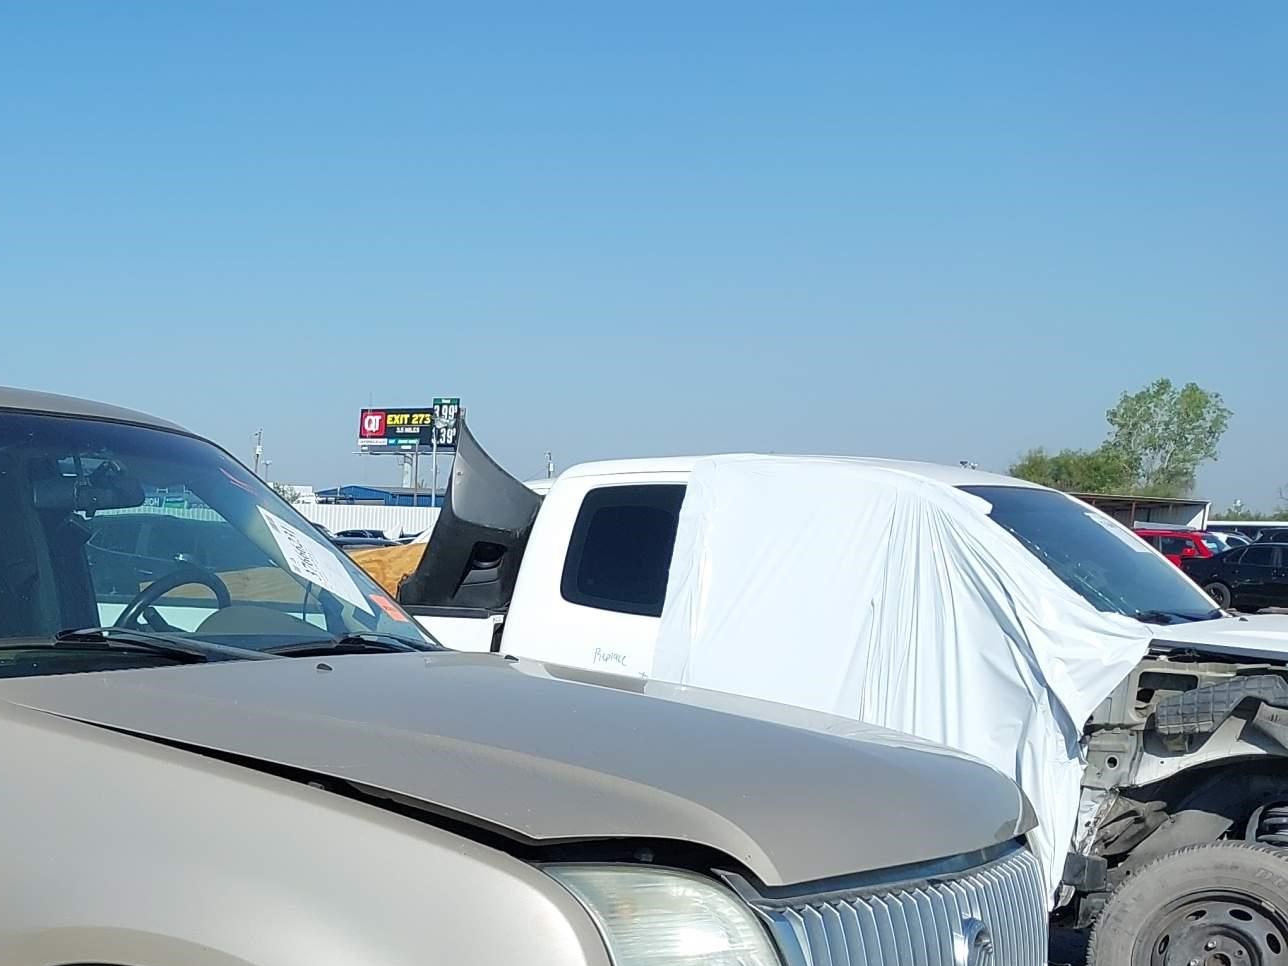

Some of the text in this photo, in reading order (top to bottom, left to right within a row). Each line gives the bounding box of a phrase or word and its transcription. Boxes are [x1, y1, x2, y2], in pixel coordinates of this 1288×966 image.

[364, 415, 381, 432] QT
[387, 414, 431, 424] EXIT 273
